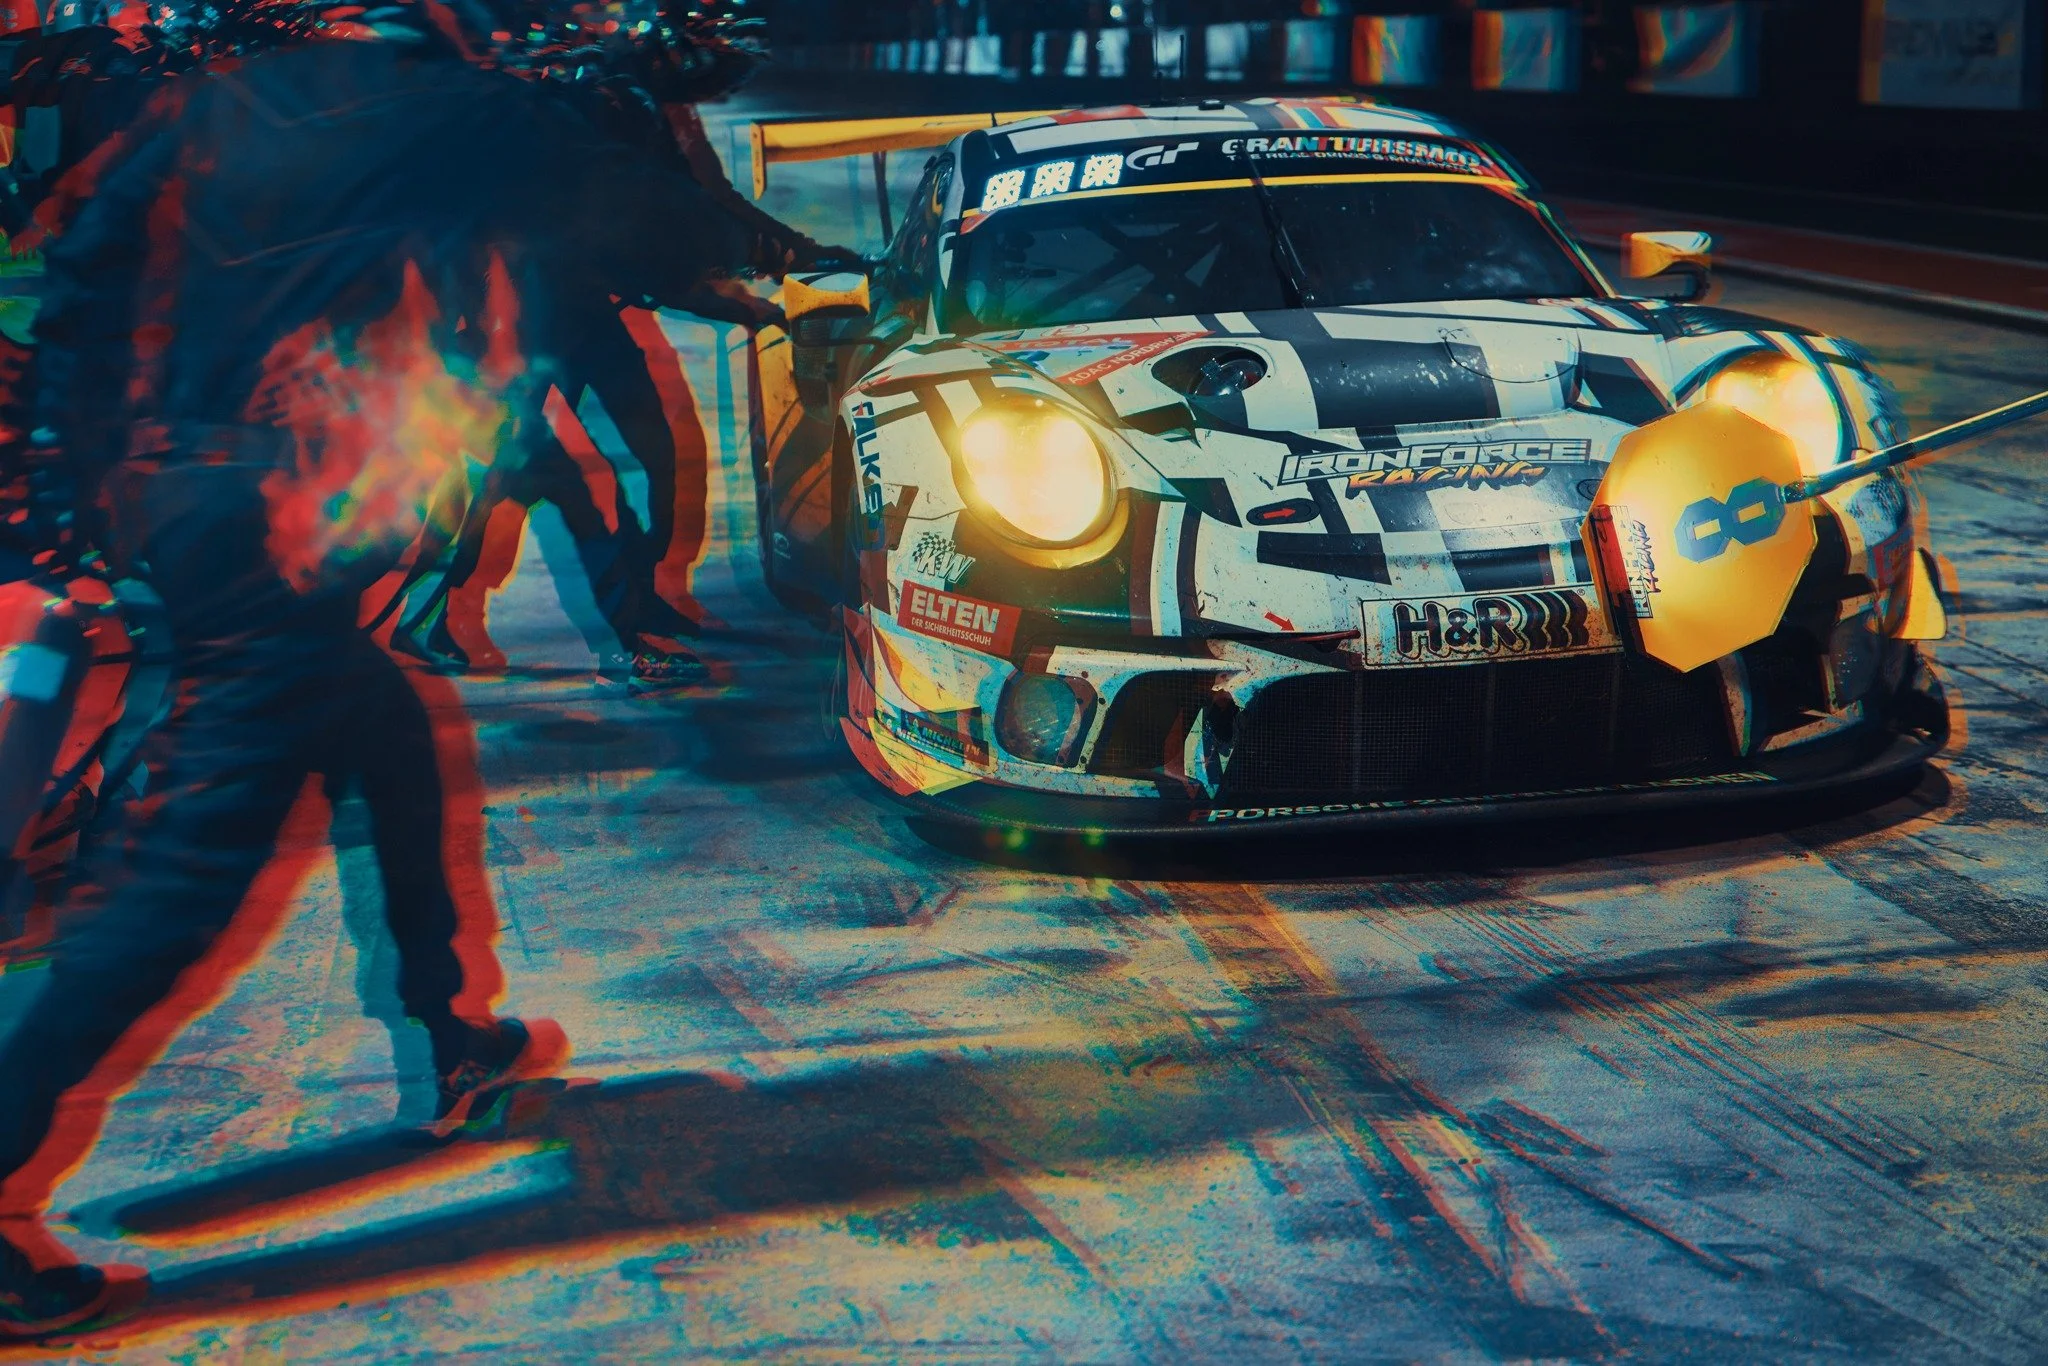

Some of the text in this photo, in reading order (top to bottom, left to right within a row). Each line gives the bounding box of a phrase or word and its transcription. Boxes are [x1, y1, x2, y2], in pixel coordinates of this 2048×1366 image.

[1227, 152, 1261, 161] TE
[1067, 362, 1112, 384] ADAC
[1280, 440, 1588, 480] IRONFORCE
[1347, 460, 1547, 491] RACING
[916, 547, 977, 584] KW
[910, 588, 1000, 634] ELTEN
[924, 620, 992, 646] SICHERHEITSSCHUH
[1394, 598, 1528, 658] H&R
[1207, 799, 1406, 823] PORSCHE
